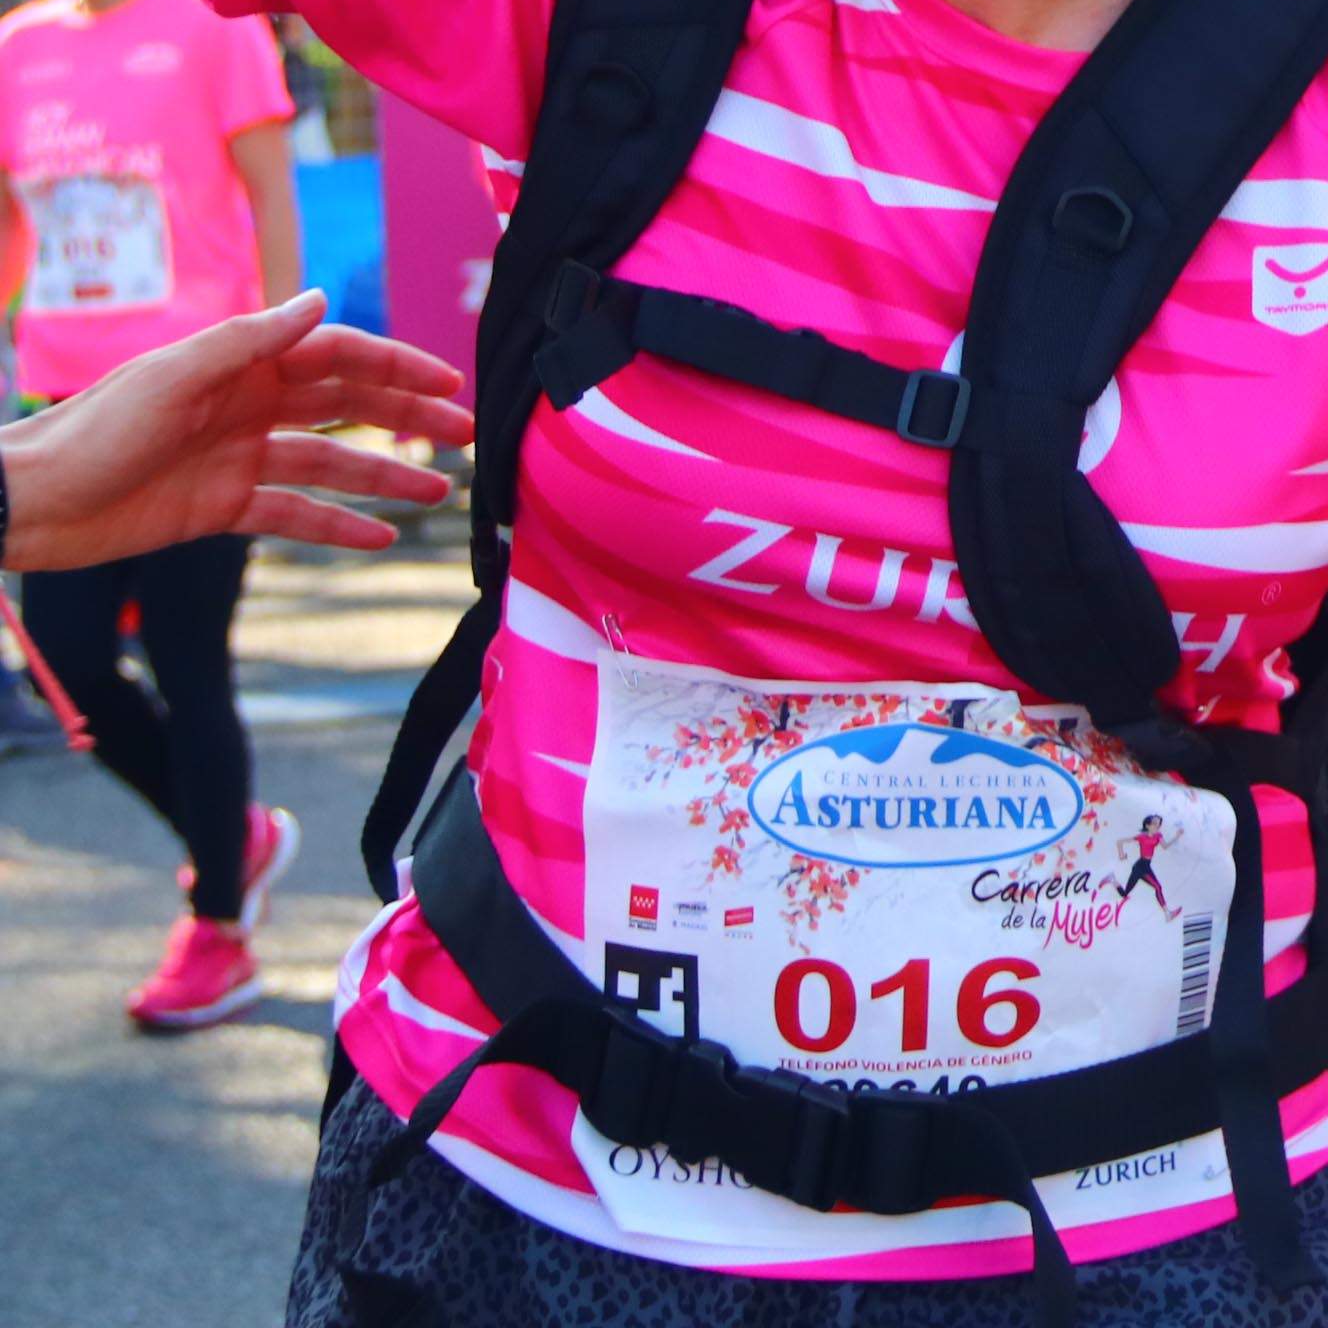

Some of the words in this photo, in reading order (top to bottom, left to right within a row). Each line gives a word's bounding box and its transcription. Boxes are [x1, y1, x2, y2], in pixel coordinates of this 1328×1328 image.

[686, 506, 1248, 674] ZURH
[770, 769, 1058, 831] ASTURIANA
[822, 768, 927, 789] CENTRAL
[940, 774, 1047, 788] LECHERA
[971, 868, 1092, 903] Carrera
[1001, 907, 1024, 929] de
[1030, 906, 1048, 929] la
[1042, 890, 1131, 951] Mujer
[773, 957, 1042, 1054] 016
[862, 1057, 943, 1072] VIOLENCIA
[947, 1054, 965, 1068] DE
[971, 1049, 1033, 1066] GÉNERO
[1075, 1151, 1177, 1191] ZURICH
